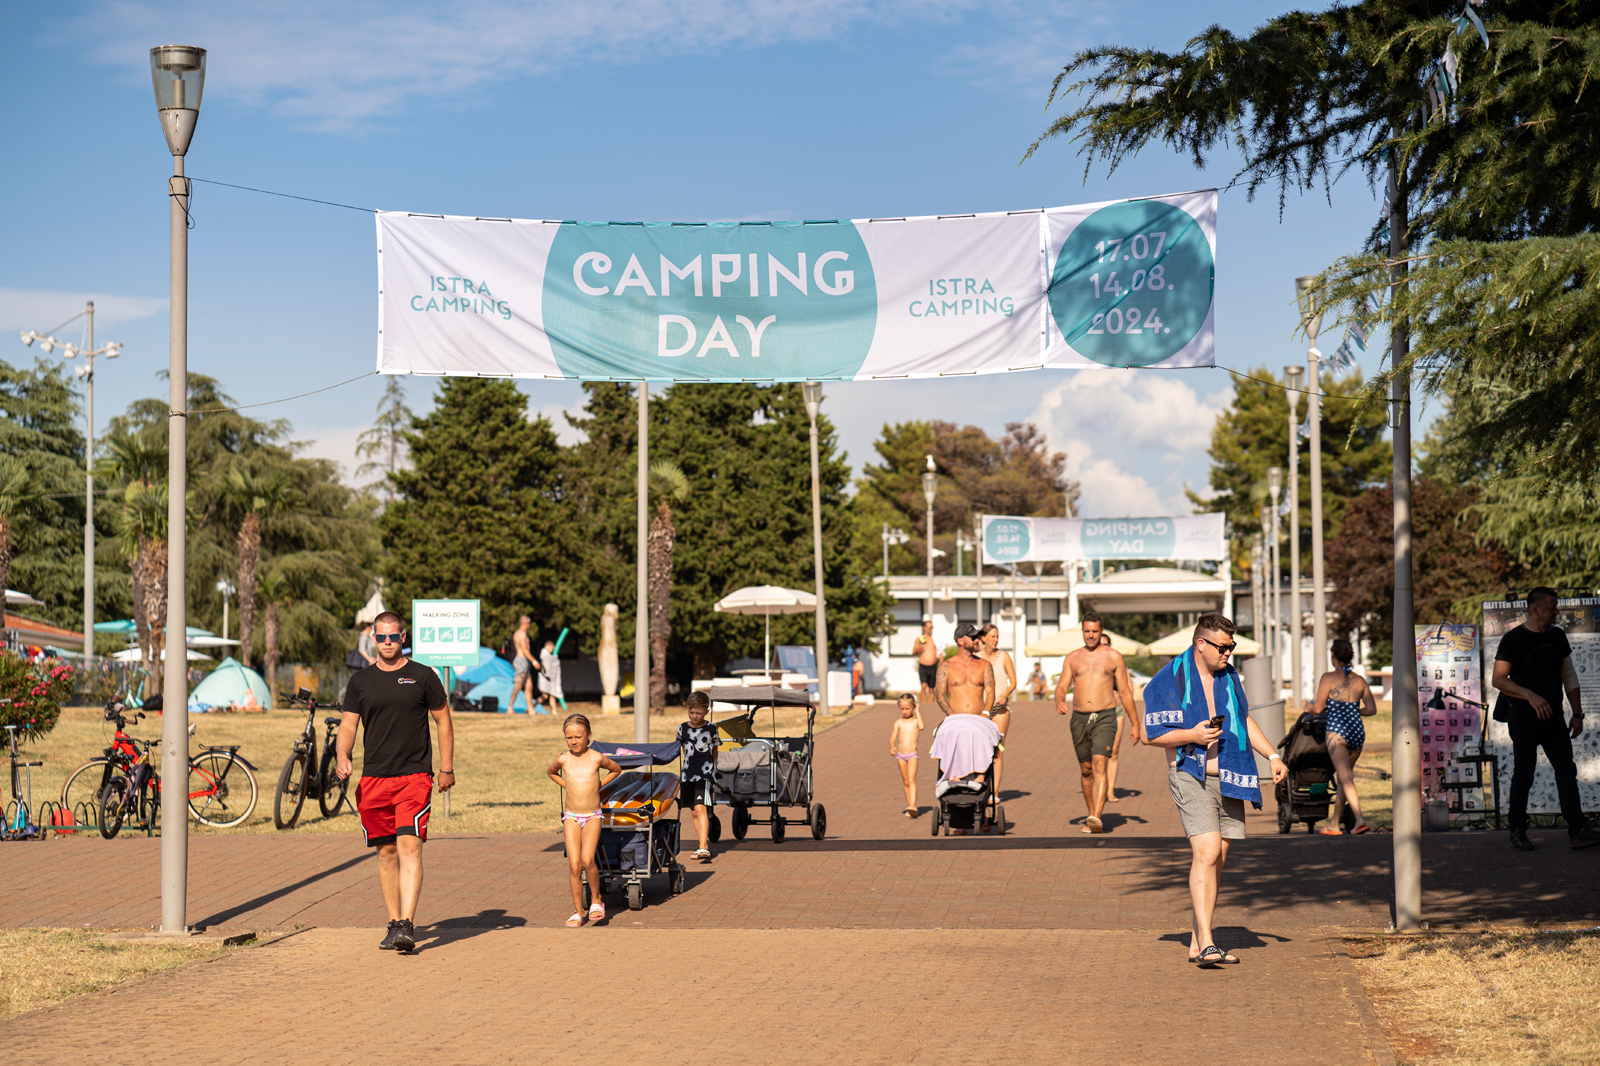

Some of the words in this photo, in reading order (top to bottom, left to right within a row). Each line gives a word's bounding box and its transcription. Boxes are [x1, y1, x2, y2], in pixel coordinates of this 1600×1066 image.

[1094, 232, 1170, 264] 17.07.
[430, 276, 492, 297] ISTRA
[572, 250, 855, 298] CAMPING
[1090, 264, 1174, 299] 14.08.
[929, 278, 996, 296] ISTRA
[410, 295, 512, 320] CAMPING
[908, 296, 1014, 318] CAMPING
[1087, 308, 1171, 334] 2024.
[658, 314, 777, 358] DAY
[1483, 600, 1511, 609] GLITTER
[1513, 600, 1528, 608] TATT
[1556, 598, 1580, 606] BRUSH
[1581, 597, 1600, 606] TATTO
